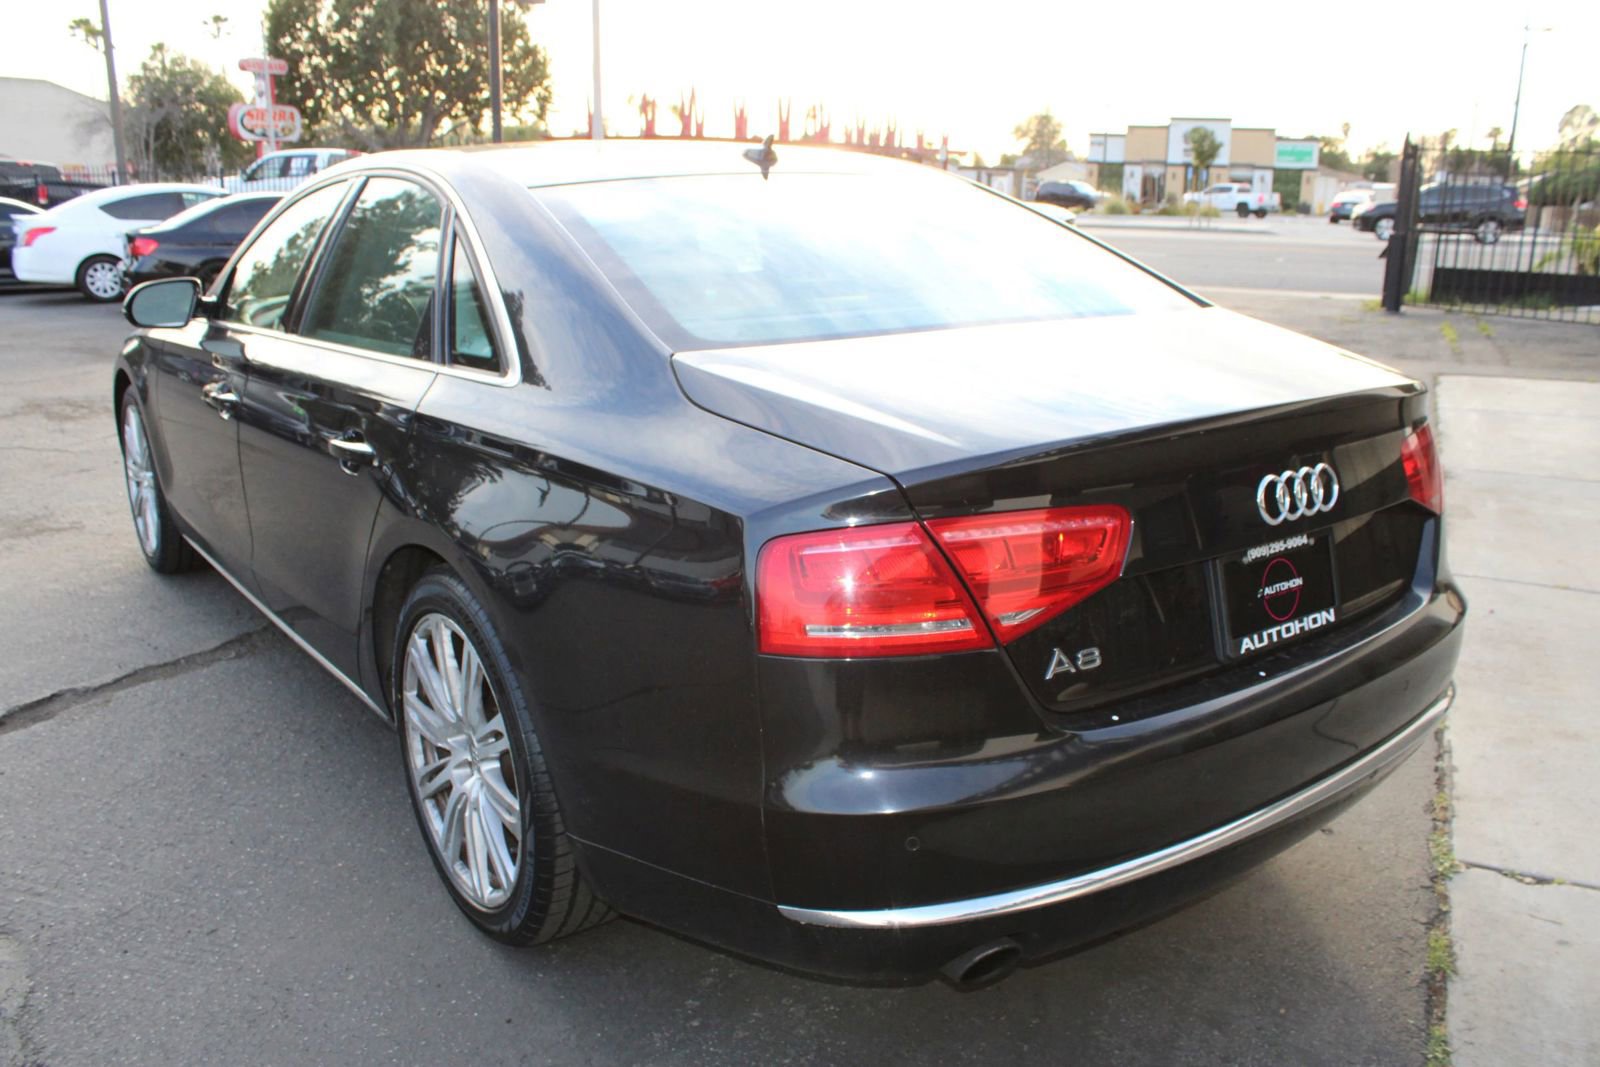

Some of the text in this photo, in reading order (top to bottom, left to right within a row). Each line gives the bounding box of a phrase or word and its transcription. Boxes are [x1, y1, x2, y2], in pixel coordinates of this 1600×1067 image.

[1263, 577, 1303, 596] AUTOHON
[1240, 608, 1336, 655] AUTOHON
[1044, 647, 1102, 680] A8
